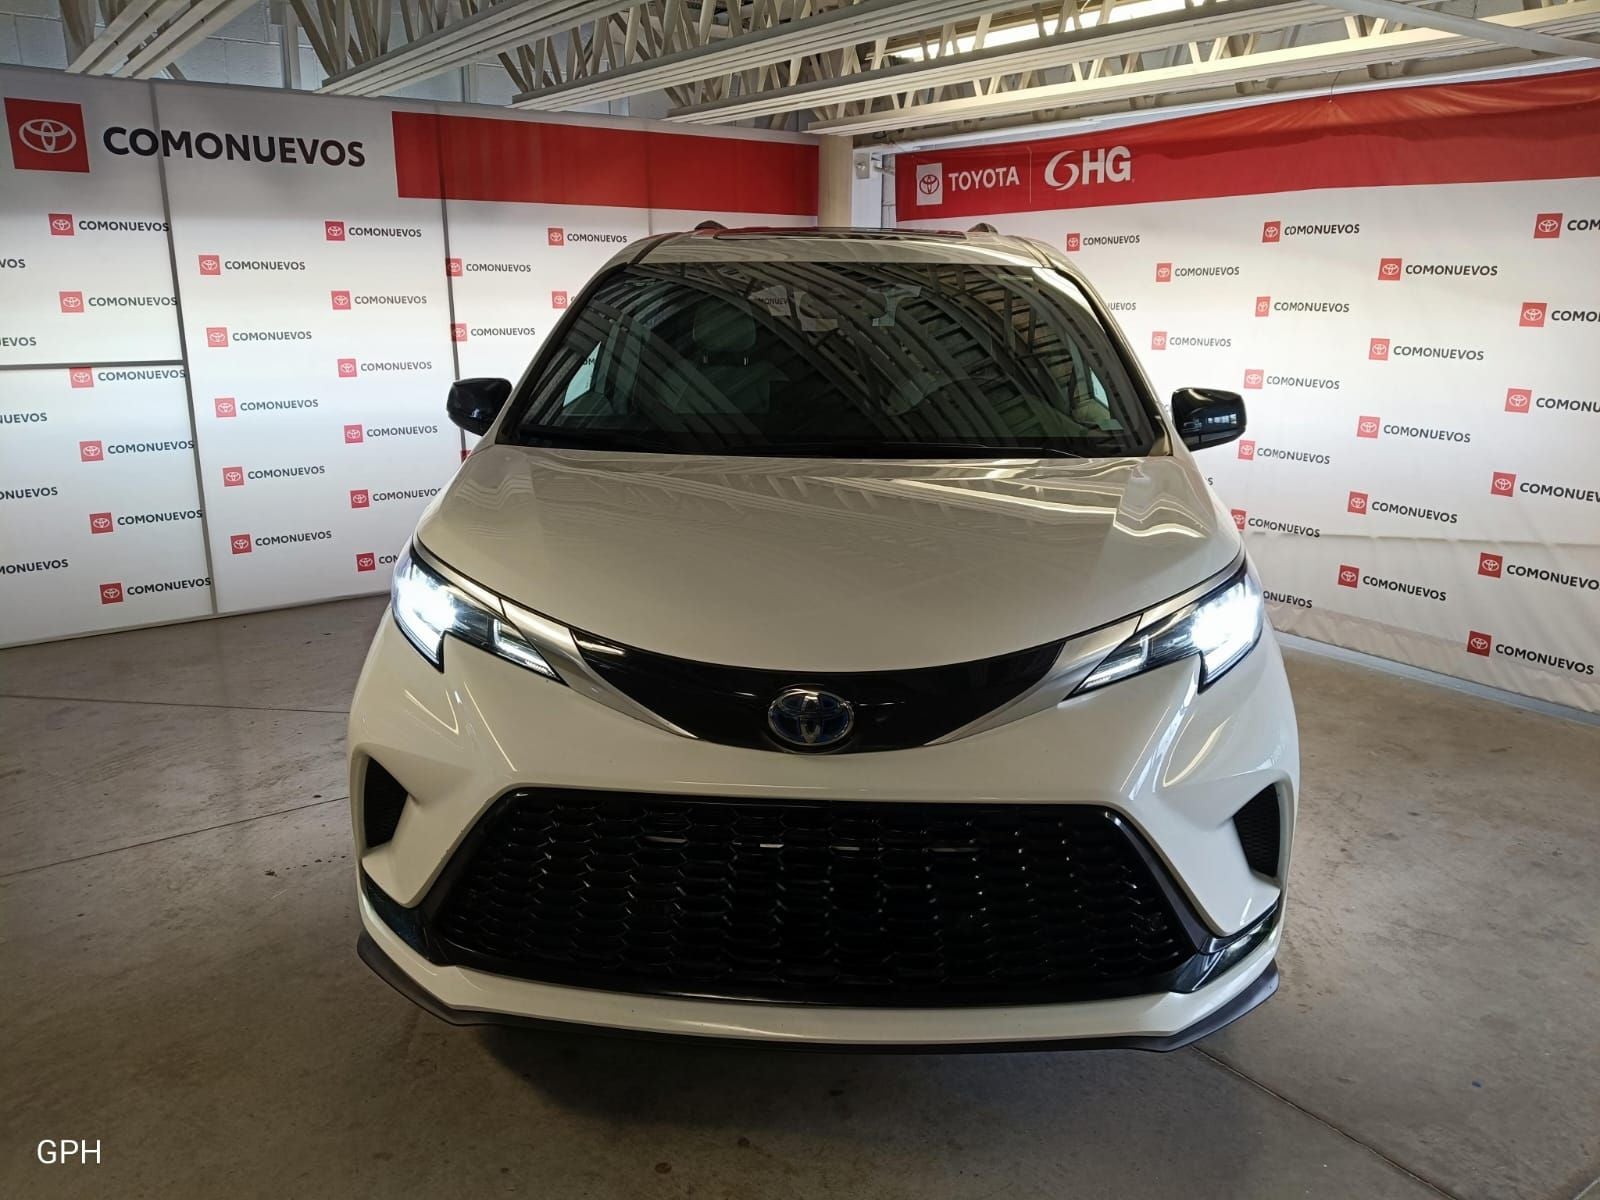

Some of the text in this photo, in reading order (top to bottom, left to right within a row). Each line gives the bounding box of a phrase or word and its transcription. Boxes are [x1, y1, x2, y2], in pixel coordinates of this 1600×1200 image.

[103, 126, 365, 168] COMONUEVOS
[948, 165, 1020, 192] TOYOTA
[79, 220, 169, 232] COMONUEVOS
[348, 226, 422, 238] COMONUEVOS
[1284, 223, 1360, 236] COMONUEVOS
[567, 234, 627, 243] COMONUEVOS
[1082, 234, 1141, 246] COMONUEVOS
[224, 260, 306, 271] COMONUEVOS
[465, 263, 532, 273] COMONUEVOS
[1174, 266, 1240, 277] COMONUEVOS
[1405, 264, 1498, 277] COMONUEVOS
[88, 297, 178, 307] COMONUEVOS
[354, 295, 428, 305] COMONUEVOS
[1108, 302, 1136, 311] UEVOS
[1273, 301, 1350, 313] COMONUEVOS
[1551, 310, 1600, 323] COMO
[232, 330, 313, 342] COMONUEVOS
[470, 327, 536, 337] COMONUEVOS
[0, 336, 37, 347] EVOS
[1169, 337, 1231, 347] COMONUEVOS
[1393, 345, 1484, 361] COMONUEVOS
[360, 361, 433, 372] COMONUEVOS
[98, 369, 186, 381] COMONUEVOS
[1266, 375, 1341, 390] COMONUEVOS
[239, 398, 319, 412] COMONUEVOS
[0, 412, 48, 425] UEVOS
[366, 425, 438, 438] COMONUEVOS
[1383, 424, 1471, 443] COMONUEVOS
[107, 440, 195, 454] COMONUEVOS
[1256, 447, 1331, 465] COMONUEVOS
[247, 465, 326, 480] COMONUEVOS
[372, 487, 442, 502] COMONUEVO
[117, 509, 203, 526] COMONUEVOS
[1371, 501, 1458, 524] COMONUEVOS
[1247, 517, 1321, 539] COMONUEVOS
[255, 530, 332, 547] COMONUEVOS
[127, 577, 211, 595] COMONUEVOS
[1362, 575, 1447, 602] COMONUEVOS
[1495, 643, 1594, 676] COMONUEVOS
